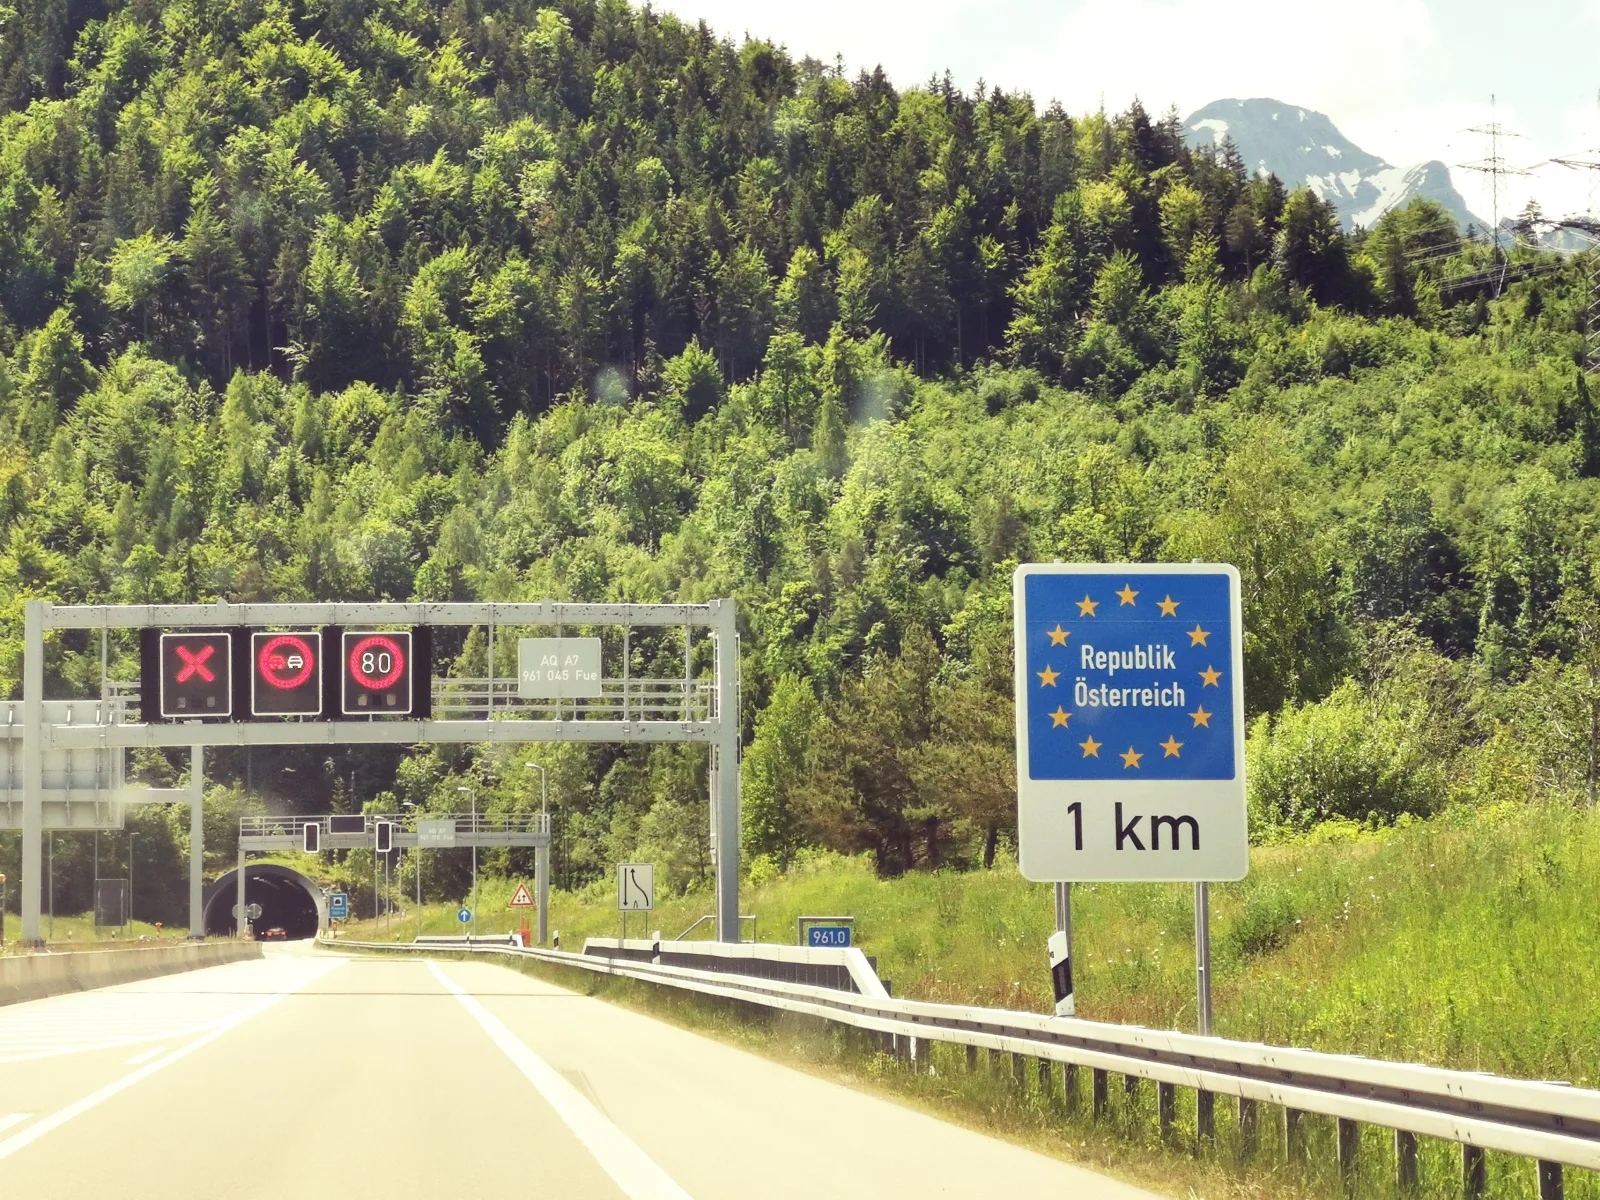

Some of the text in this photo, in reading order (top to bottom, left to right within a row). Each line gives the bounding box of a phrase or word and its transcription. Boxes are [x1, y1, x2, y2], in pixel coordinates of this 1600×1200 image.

[361, 652, 391, 674] 80
[540, 655, 580, 667] AQ A7
[1081, 644, 1176, 677] Republik
[522, 670, 597, 682] 961 045 Fue
[1074, 676, 1186, 707] Österreich
[1067, 801, 1201, 851] 1 km
